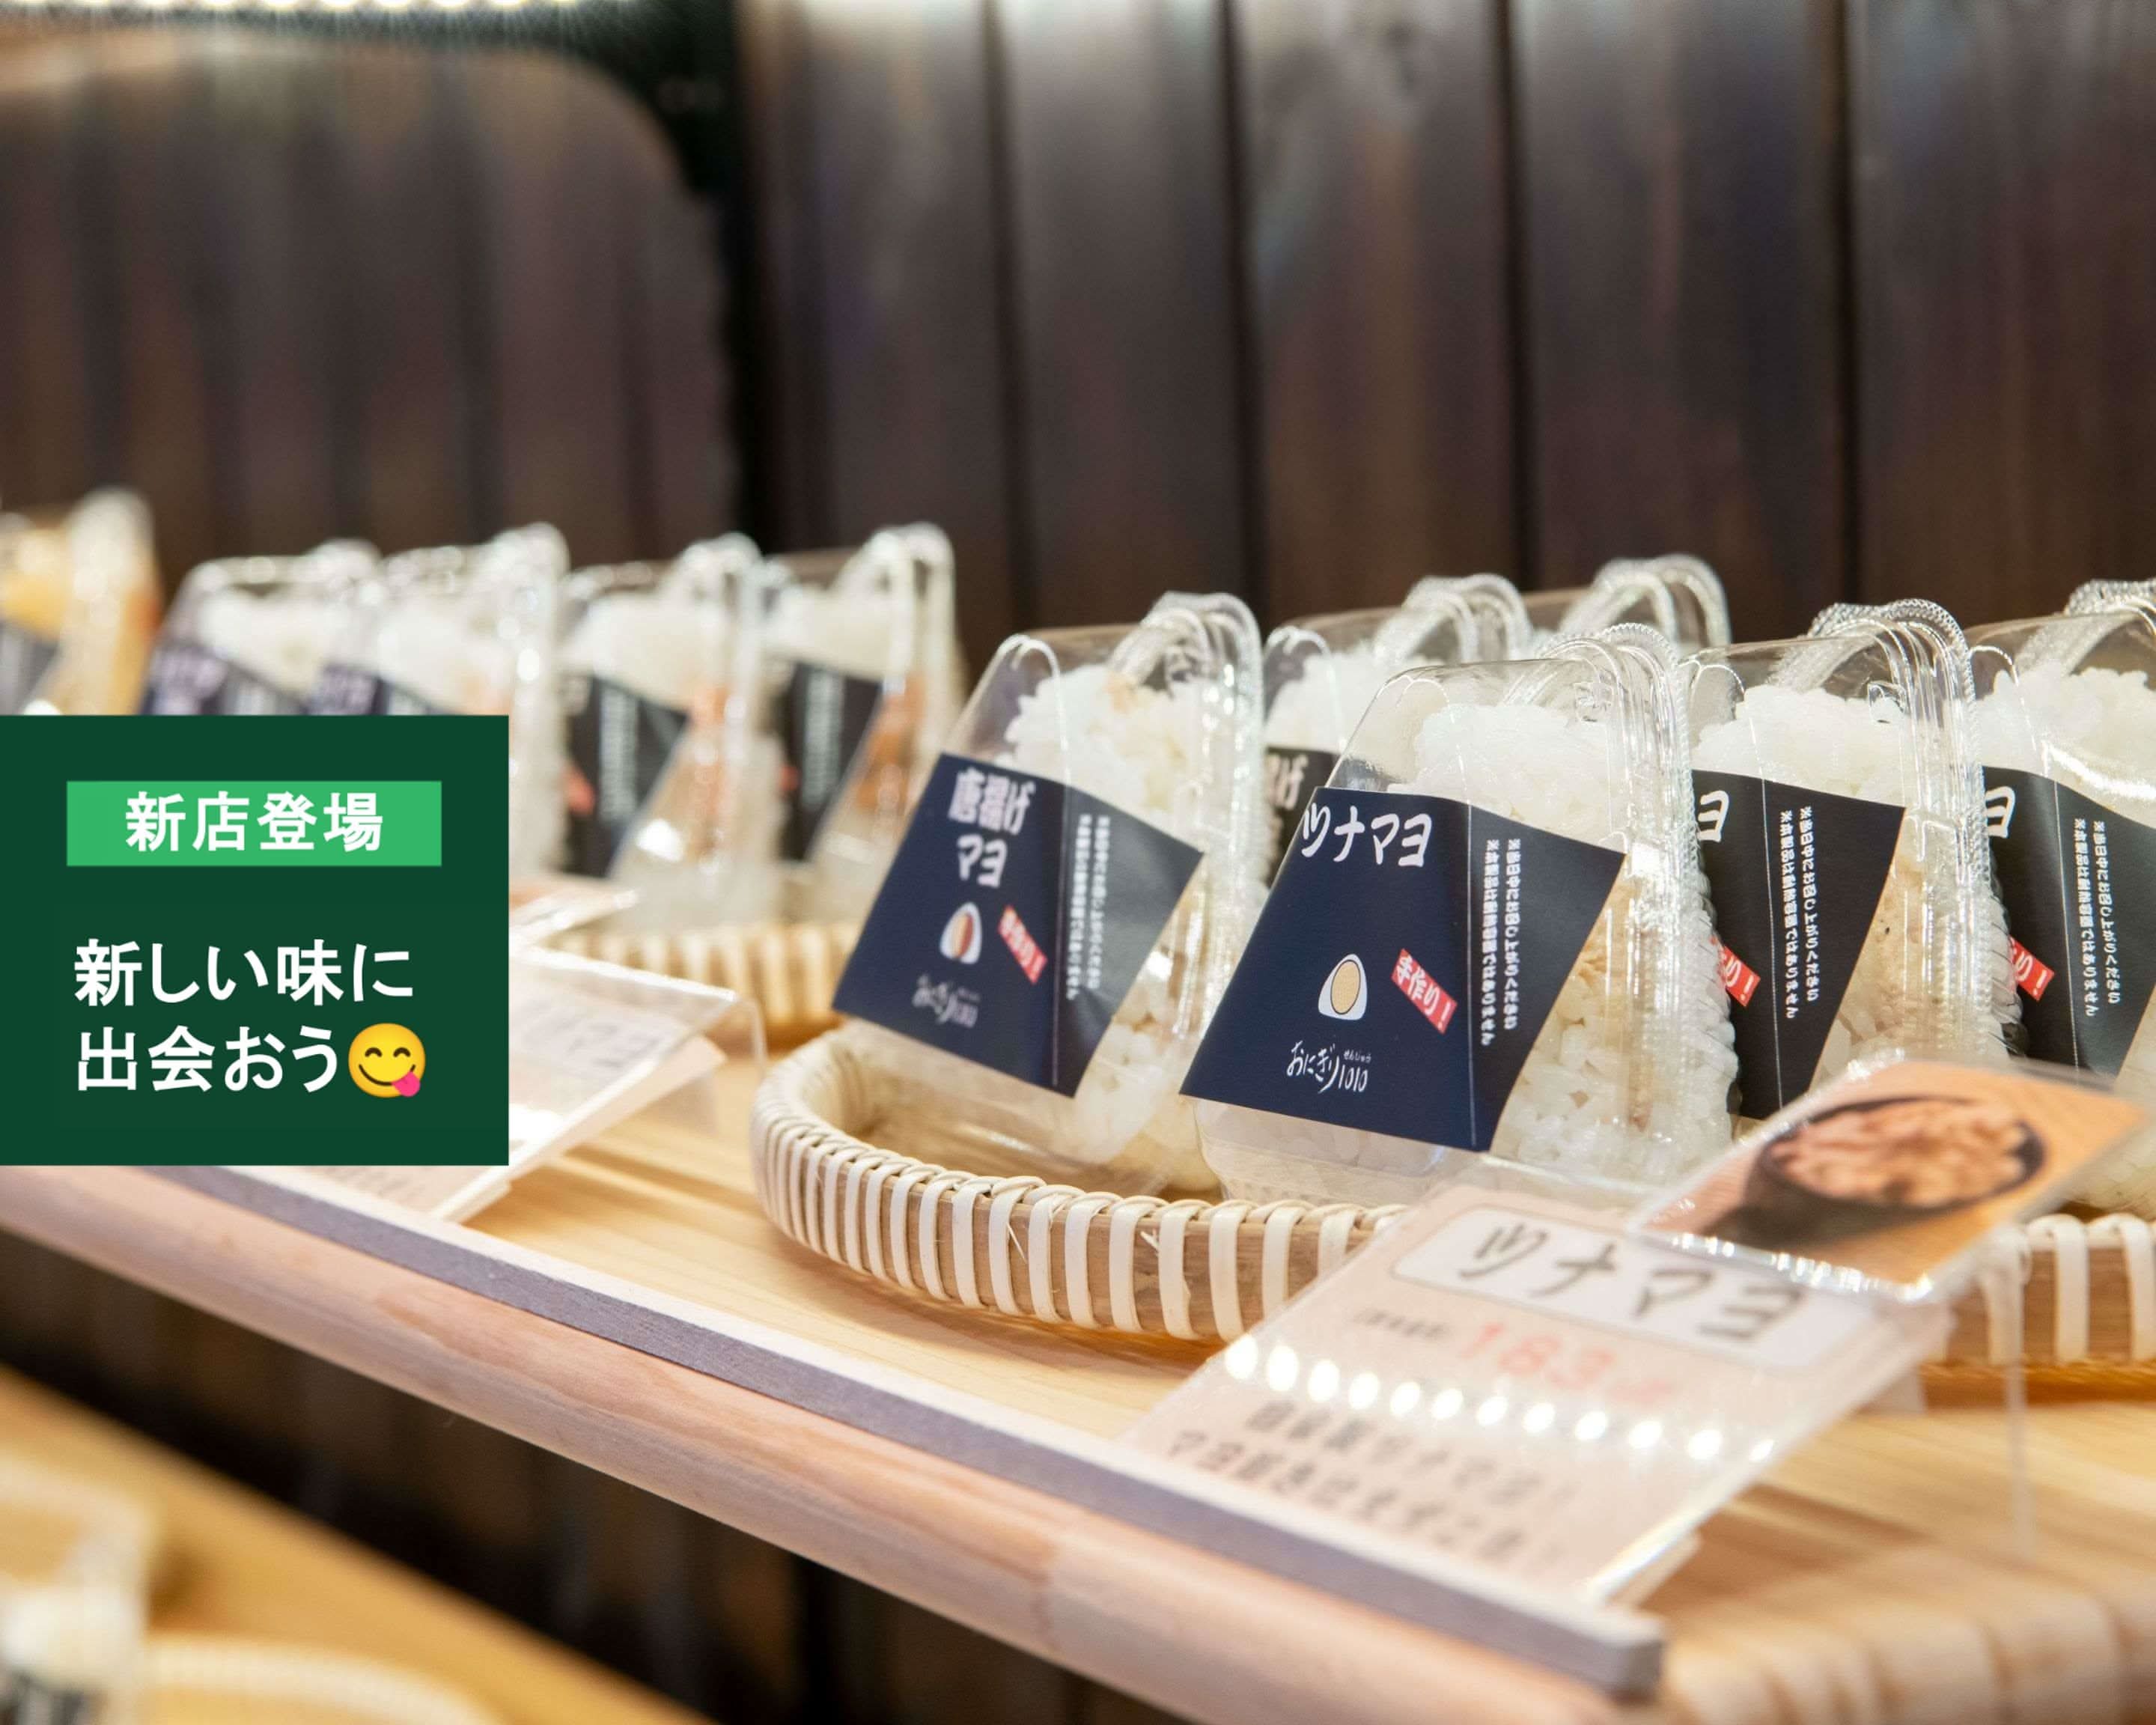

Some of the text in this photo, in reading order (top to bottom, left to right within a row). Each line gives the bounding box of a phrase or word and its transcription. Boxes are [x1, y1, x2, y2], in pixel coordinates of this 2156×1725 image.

[957, 834, 1008, 889] マヨ
[1301, 803, 1432, 867] ツナマヨ
[1458, 1223, 1806, 1341] ツナマヨ
